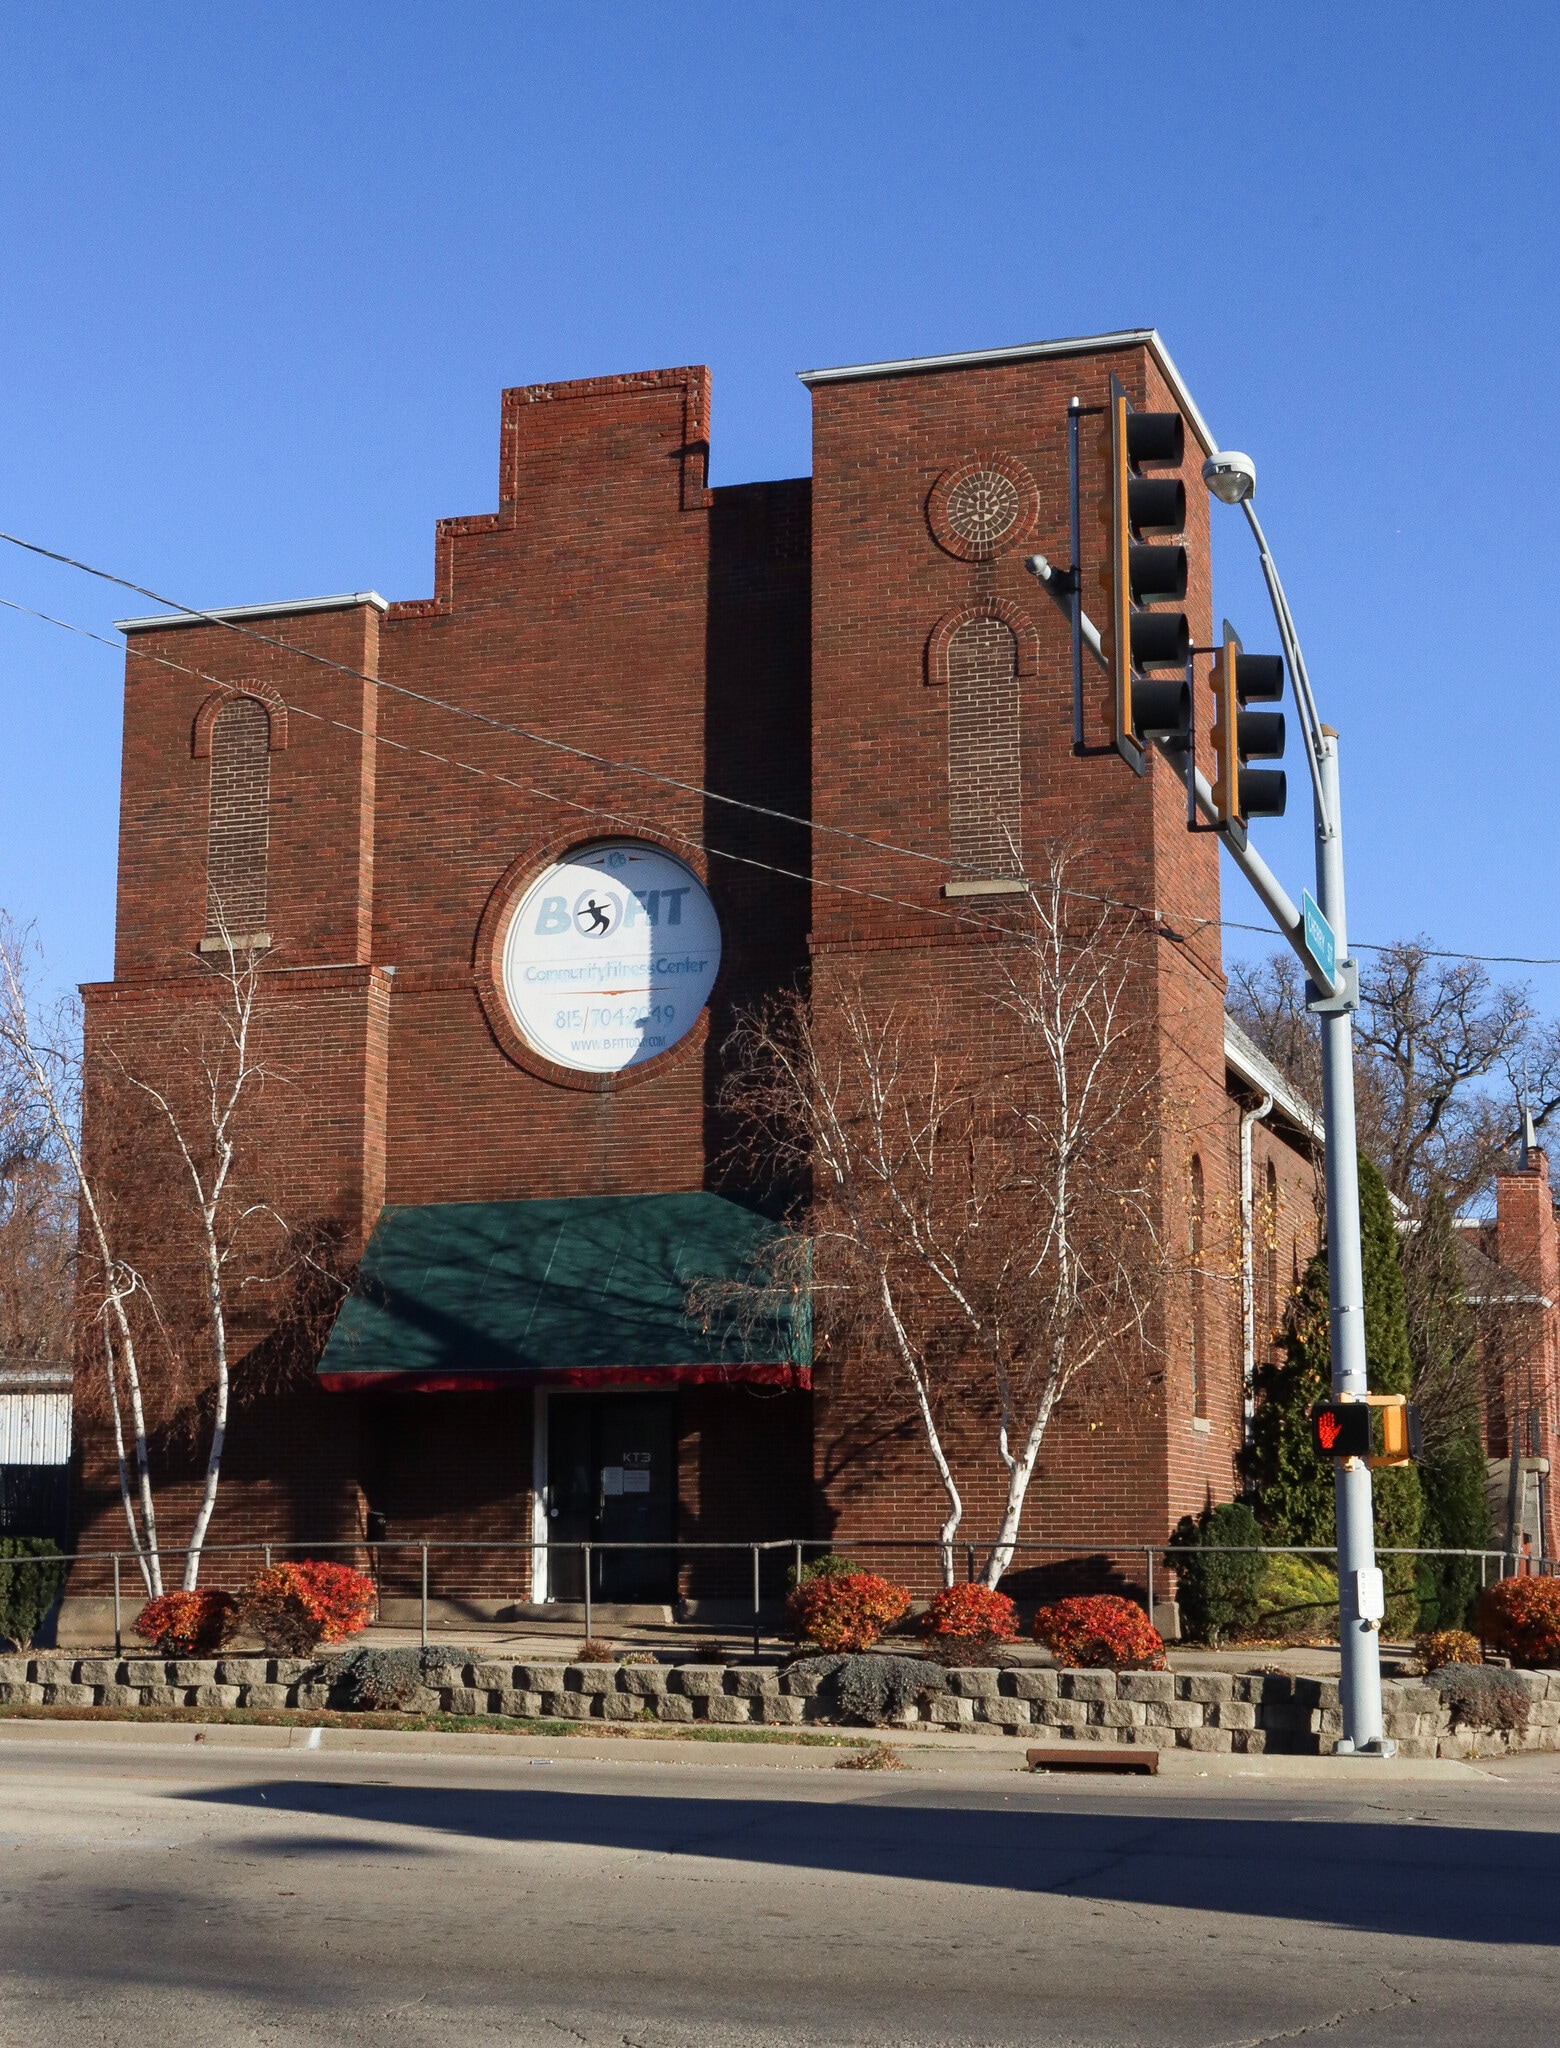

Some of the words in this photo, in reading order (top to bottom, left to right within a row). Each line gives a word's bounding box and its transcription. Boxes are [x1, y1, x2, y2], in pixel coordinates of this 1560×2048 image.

[1307, 911, 1325, 954] CHERRY
[525, 962, 607, 983] Community
[655, 956, 708, 975] Center
